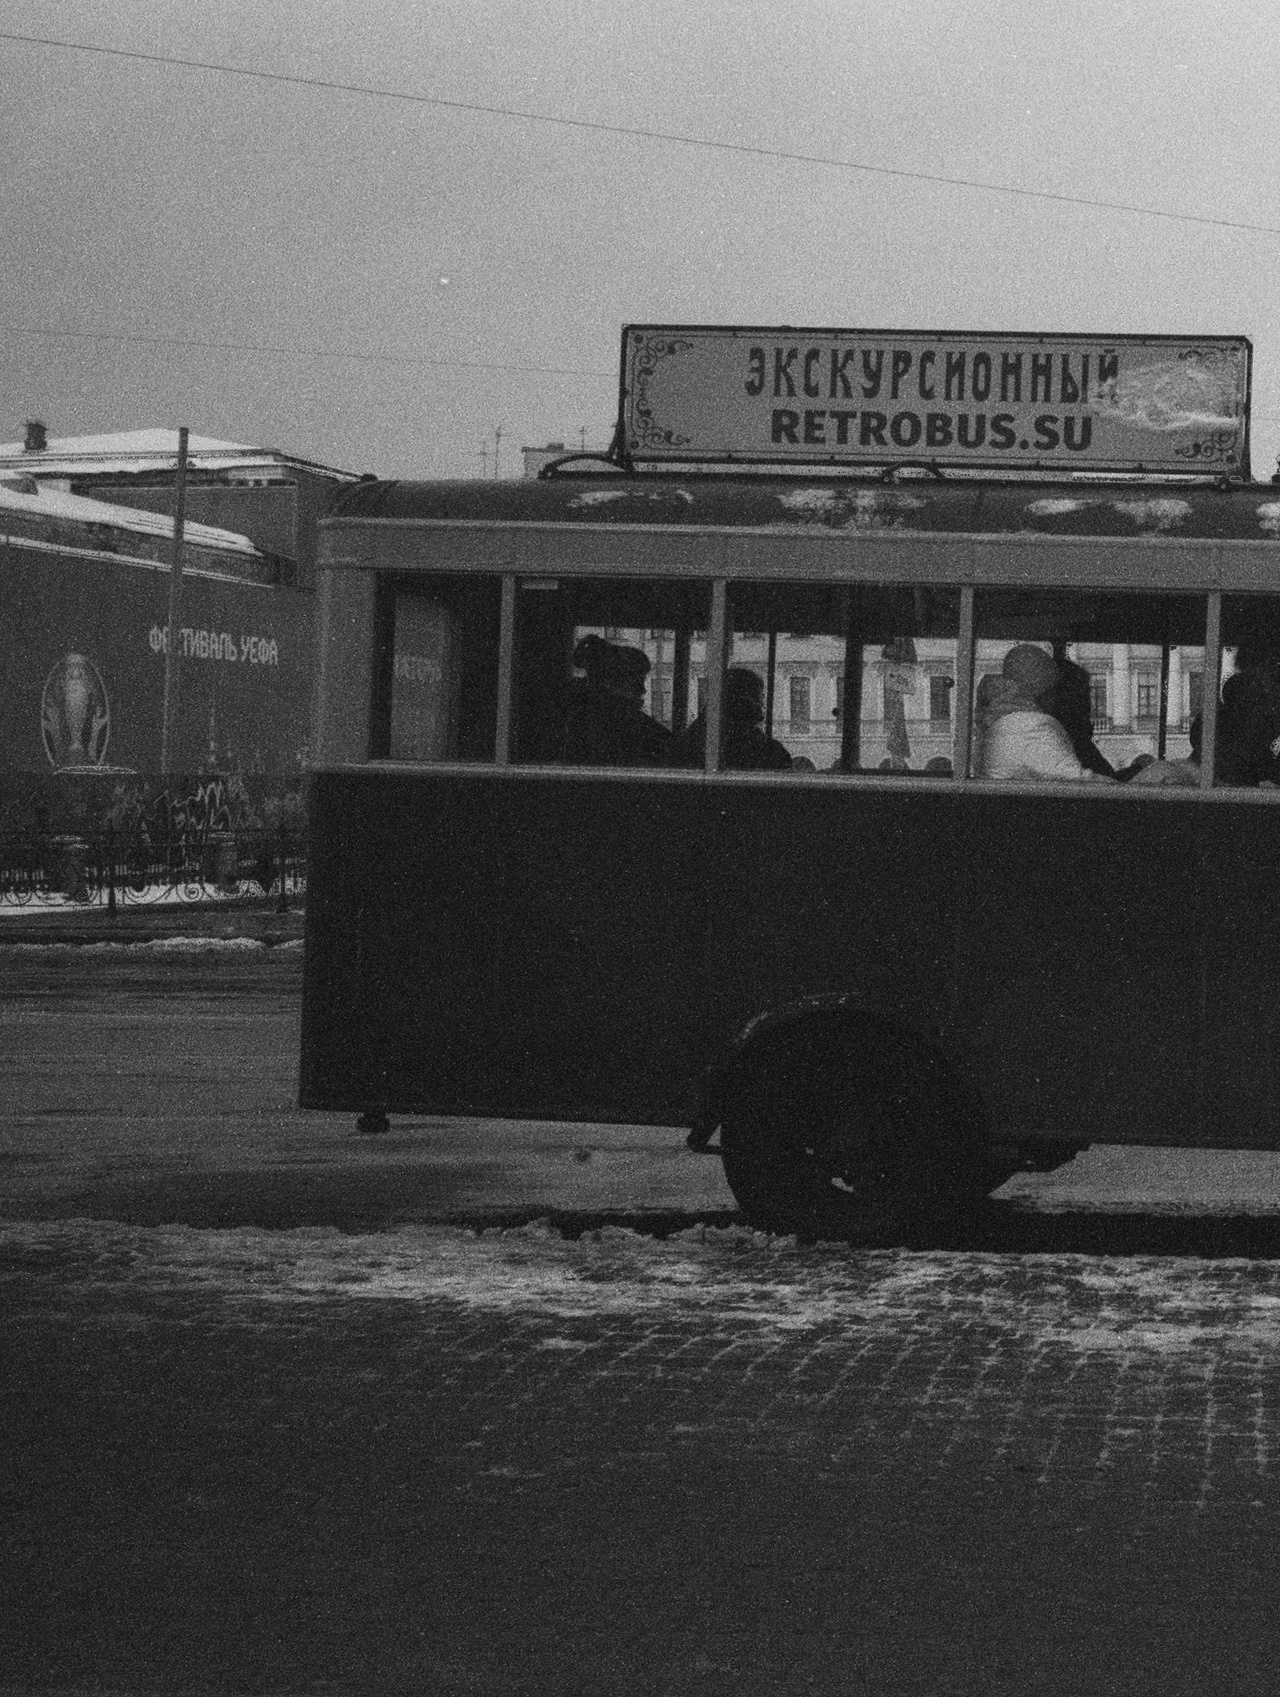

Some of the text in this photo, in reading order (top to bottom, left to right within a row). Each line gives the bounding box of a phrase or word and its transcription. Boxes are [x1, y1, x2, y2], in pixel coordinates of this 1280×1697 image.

[744, 347, 1118, 404] ЭКСКУРСИОННЫЙ
[771, 409, 1092, 451] RETROBUS.SU
[240, 635, 279, 666] УЕФА
